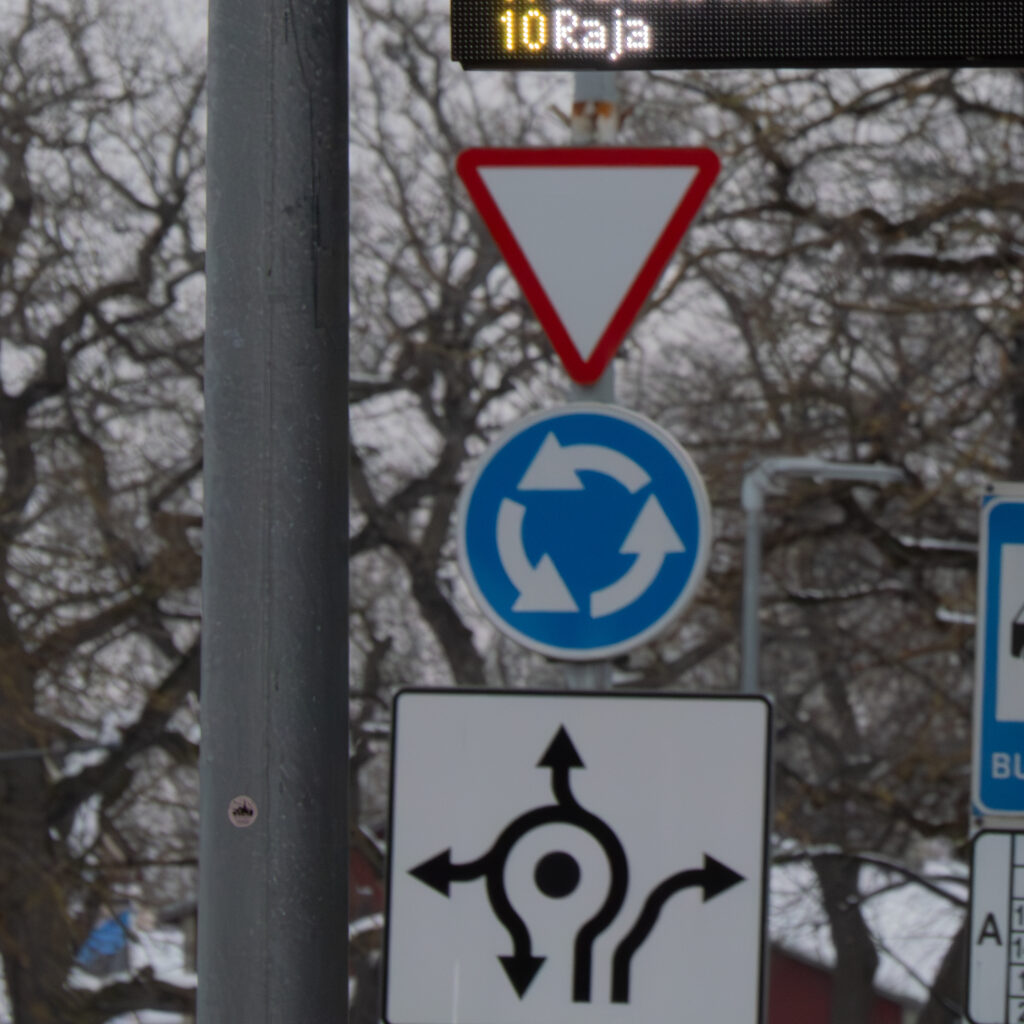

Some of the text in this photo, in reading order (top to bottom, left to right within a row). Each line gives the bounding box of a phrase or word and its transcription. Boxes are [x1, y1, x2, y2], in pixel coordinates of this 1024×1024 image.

[500, 9, 548, 52] 10
[553, 8, 652, 60] Raja
[977, 913, 1003, 946] A
